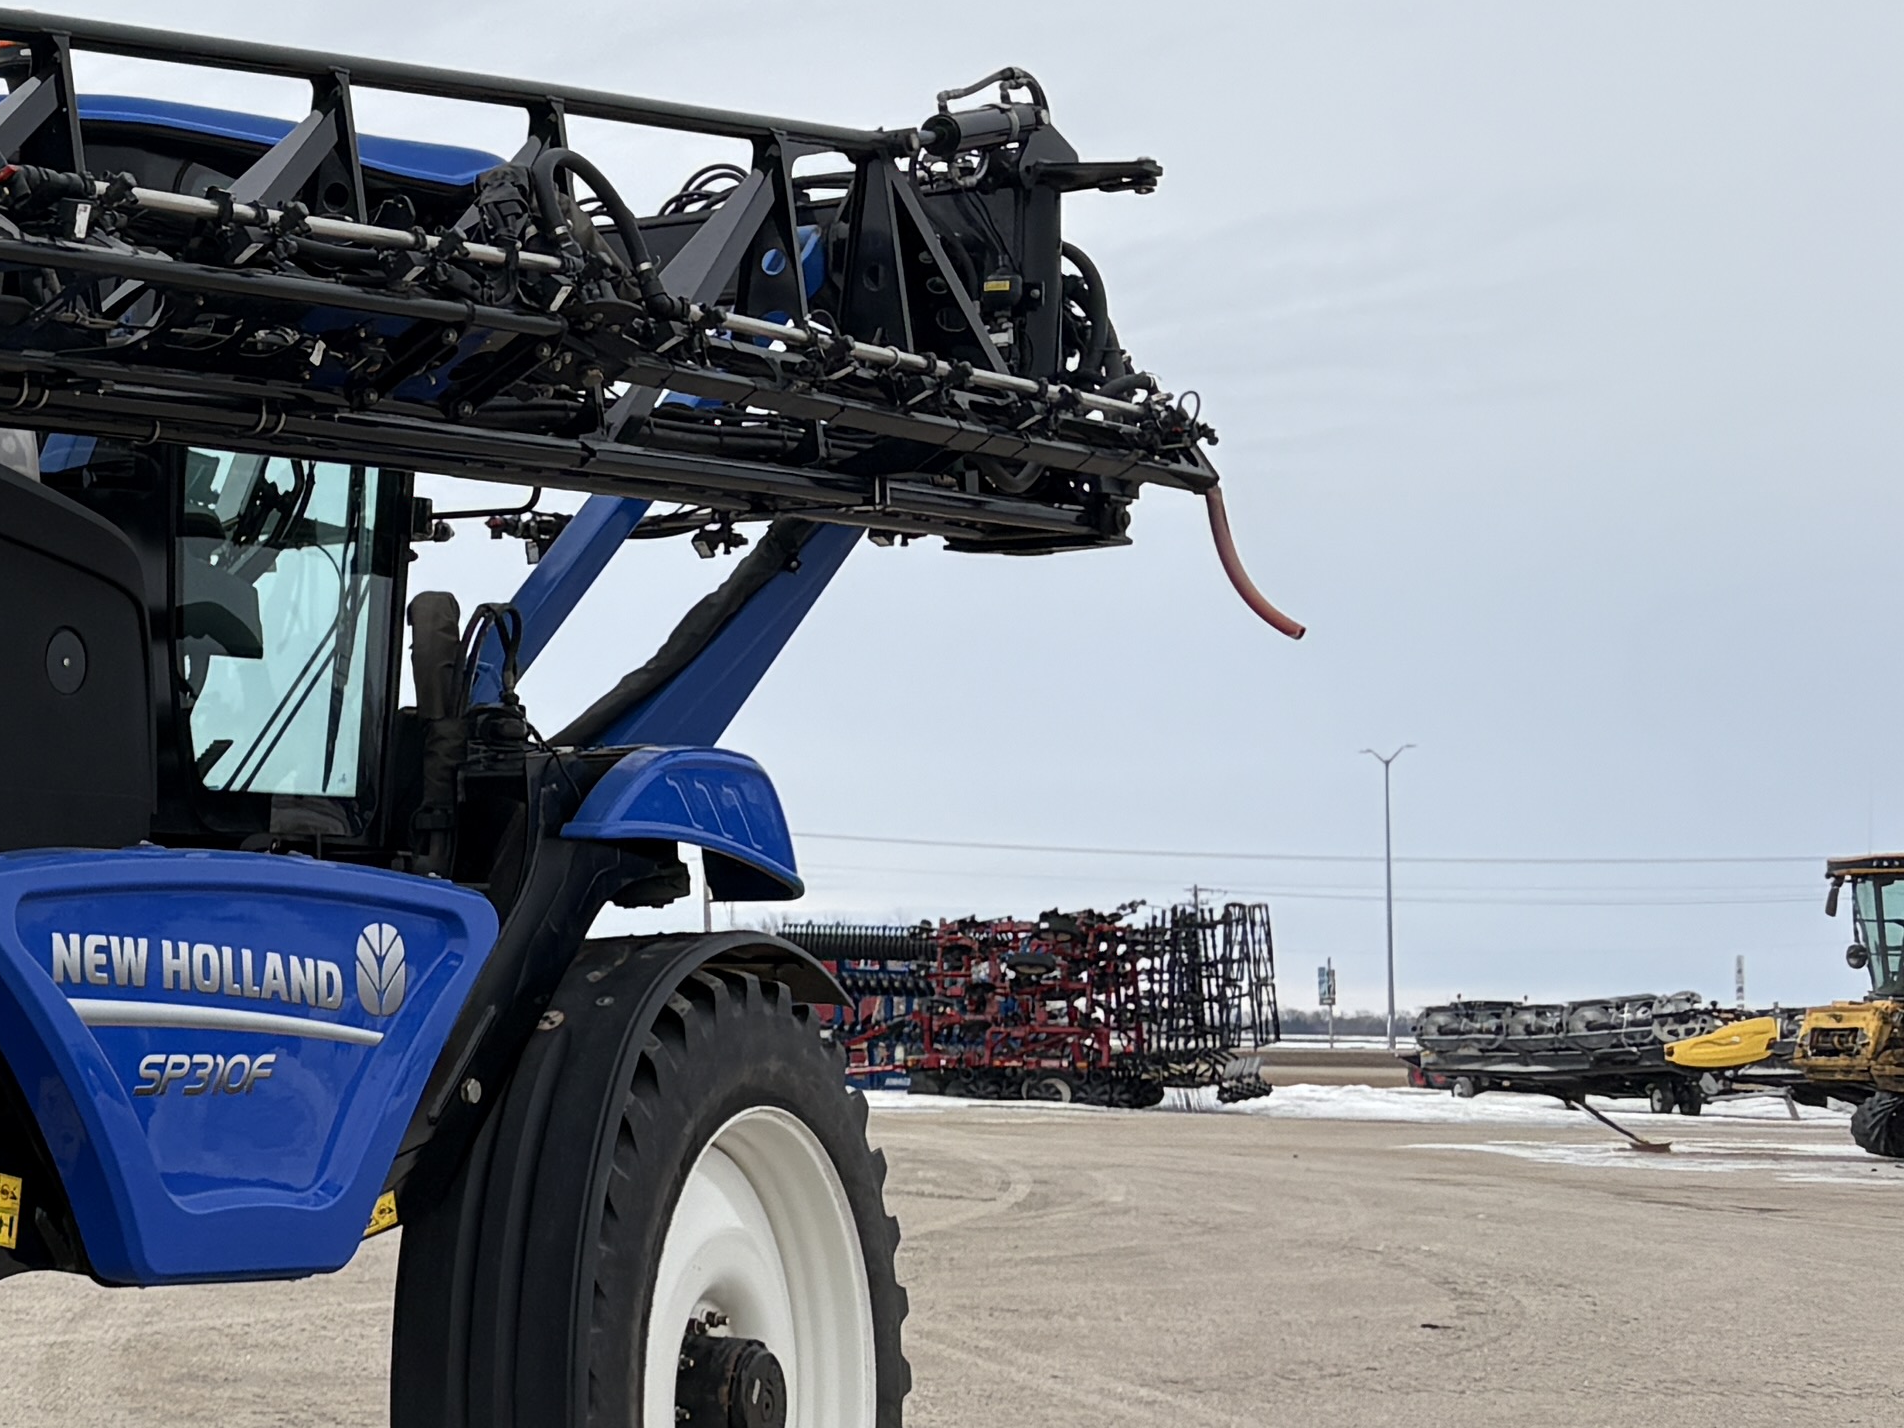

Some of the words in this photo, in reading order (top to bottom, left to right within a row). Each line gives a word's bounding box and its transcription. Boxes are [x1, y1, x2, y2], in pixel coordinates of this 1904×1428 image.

[51, 932, 148, 987] NEW
[161, 939, 343, 1010] HOLLAND
[133, 1053, 276, 1096] SP310F
